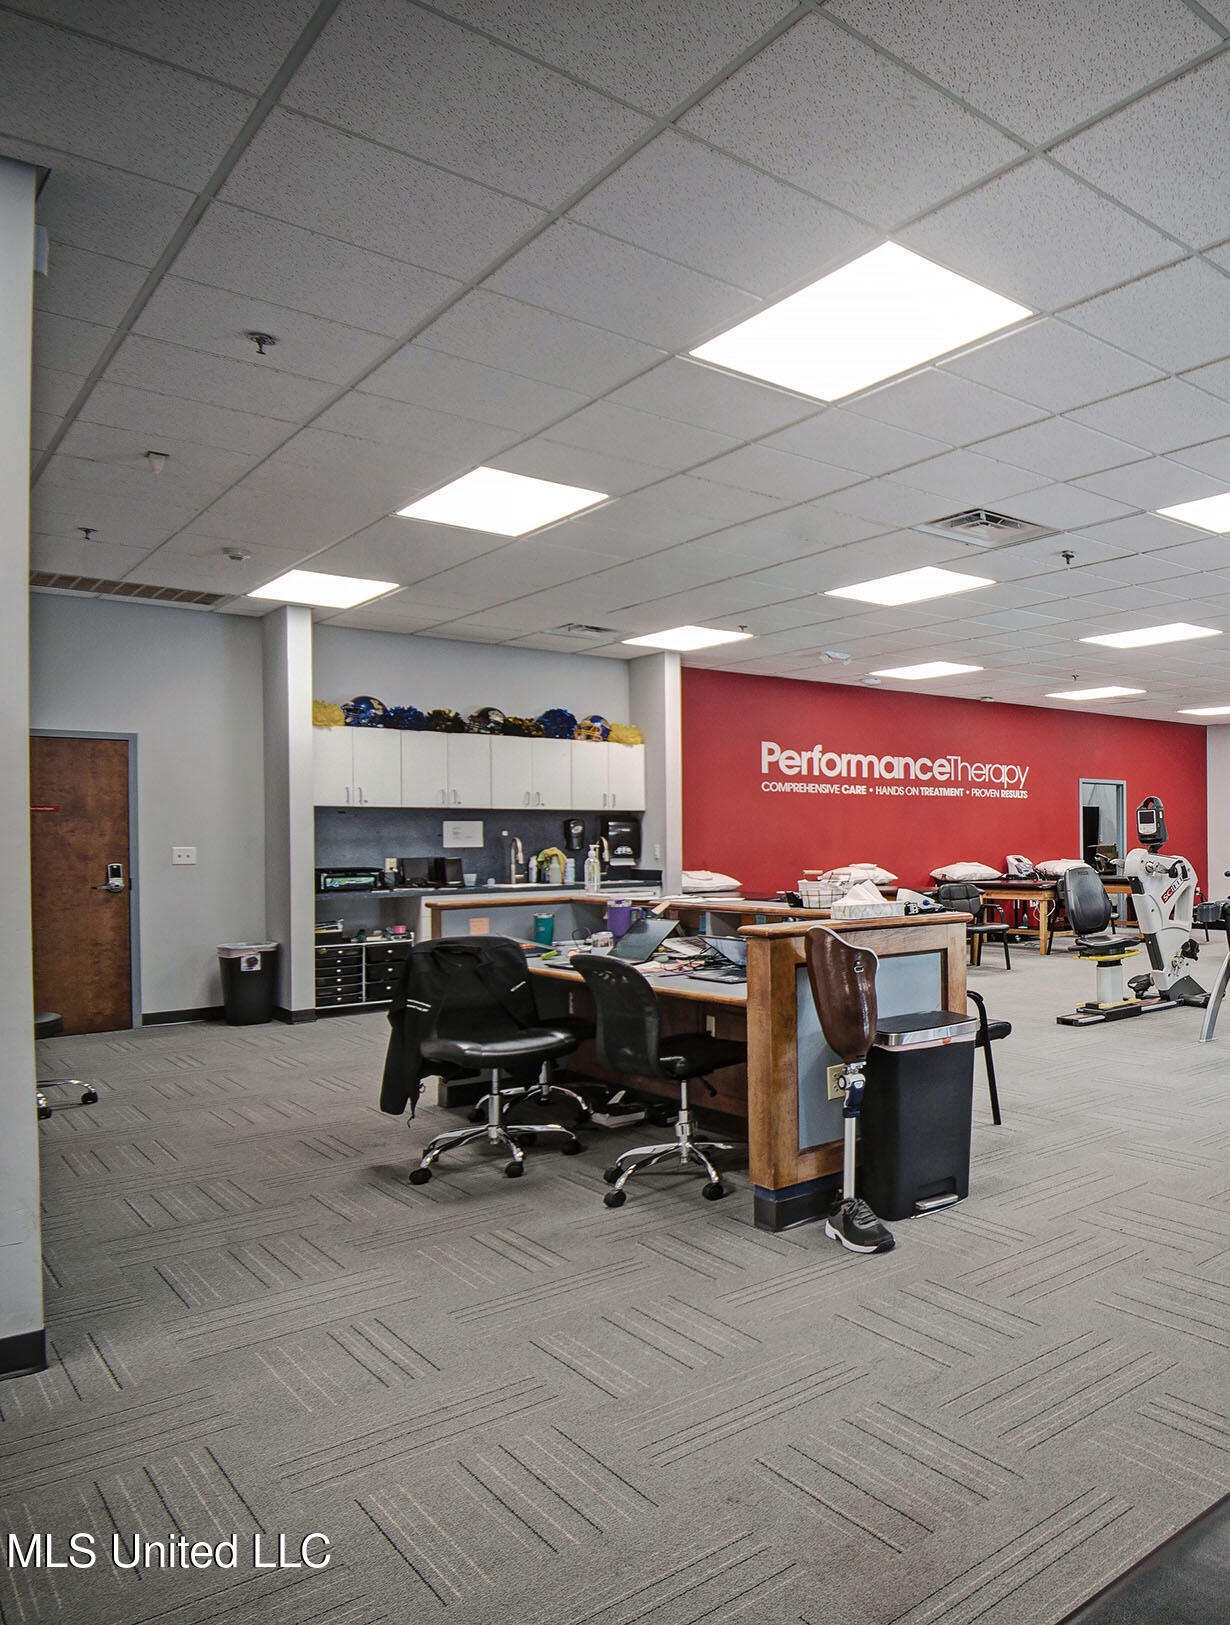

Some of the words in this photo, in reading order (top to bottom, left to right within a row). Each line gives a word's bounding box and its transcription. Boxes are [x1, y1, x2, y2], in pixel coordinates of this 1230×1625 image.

[761, 781, 840, 794] COMPREHENSIVE
[842, 784, 867, 795] CARE
[875, 785, 904, 796] HANDS
[905, 786, 919, 796] ON
[920, 786, 964, 797] TREATMENT
[971, 788, 1000, 798] PROVEN
[1001, 789, 1028, 799] RESULTS
